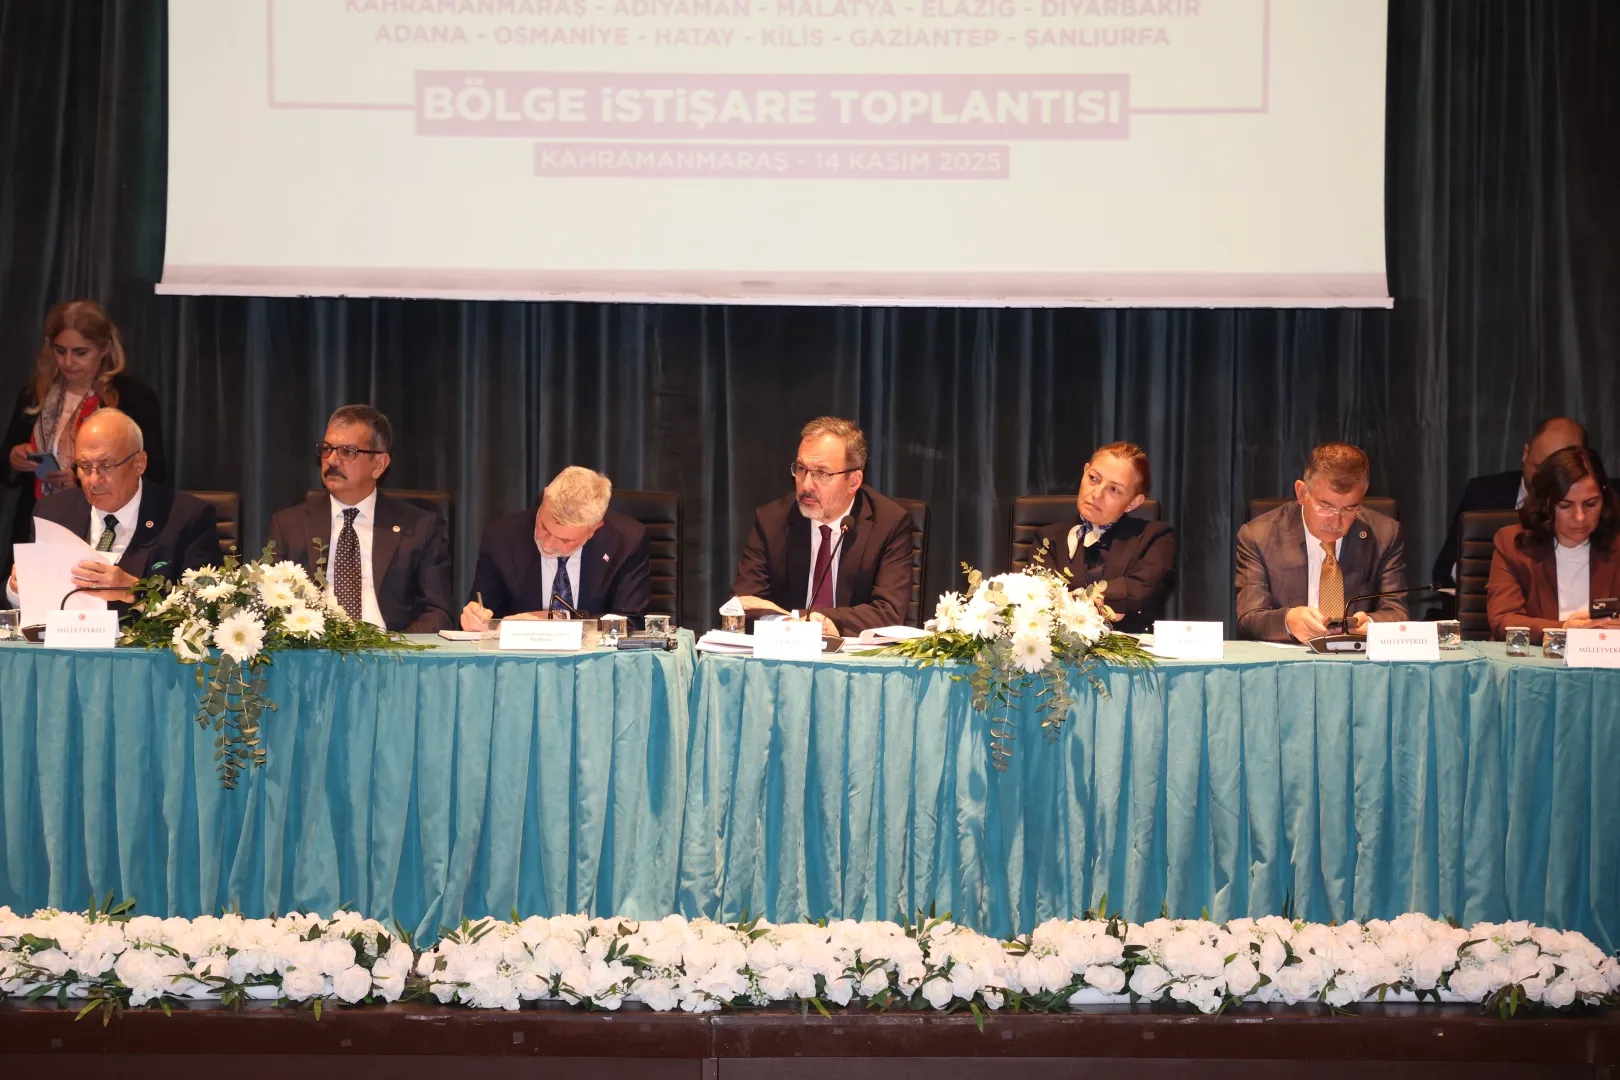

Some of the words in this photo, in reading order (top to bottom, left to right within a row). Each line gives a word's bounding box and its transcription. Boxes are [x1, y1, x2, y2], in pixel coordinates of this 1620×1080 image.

[345, 0, 586, 18] KAHRAMANMARAŞ
[613, 0, 751, 17] ADIYAMAN
[776, 0, 896, 18] MALATYA
[375, 24, 468, 44] ADANA
[493, 24, 629, 46] OSMANİYE
[654, 28, 735, 46] HATAY
[761, 24, 825, 47] KİLİS
[848, 25, 999, 47] GAZİANTEP
[1024, 27, 1171, 50] ŞANLIURFA
[424, 78, 587, 122] BÖLGE
[830, 89, 1121, 125] TOPLANTISI
[541, 150, 789, 173] KAHRAMANMARAŞ
[814, 152, 840, 171] 14
[849, 152, 930, 172] KASIM
[939, 152, 1001, 172] 2025
